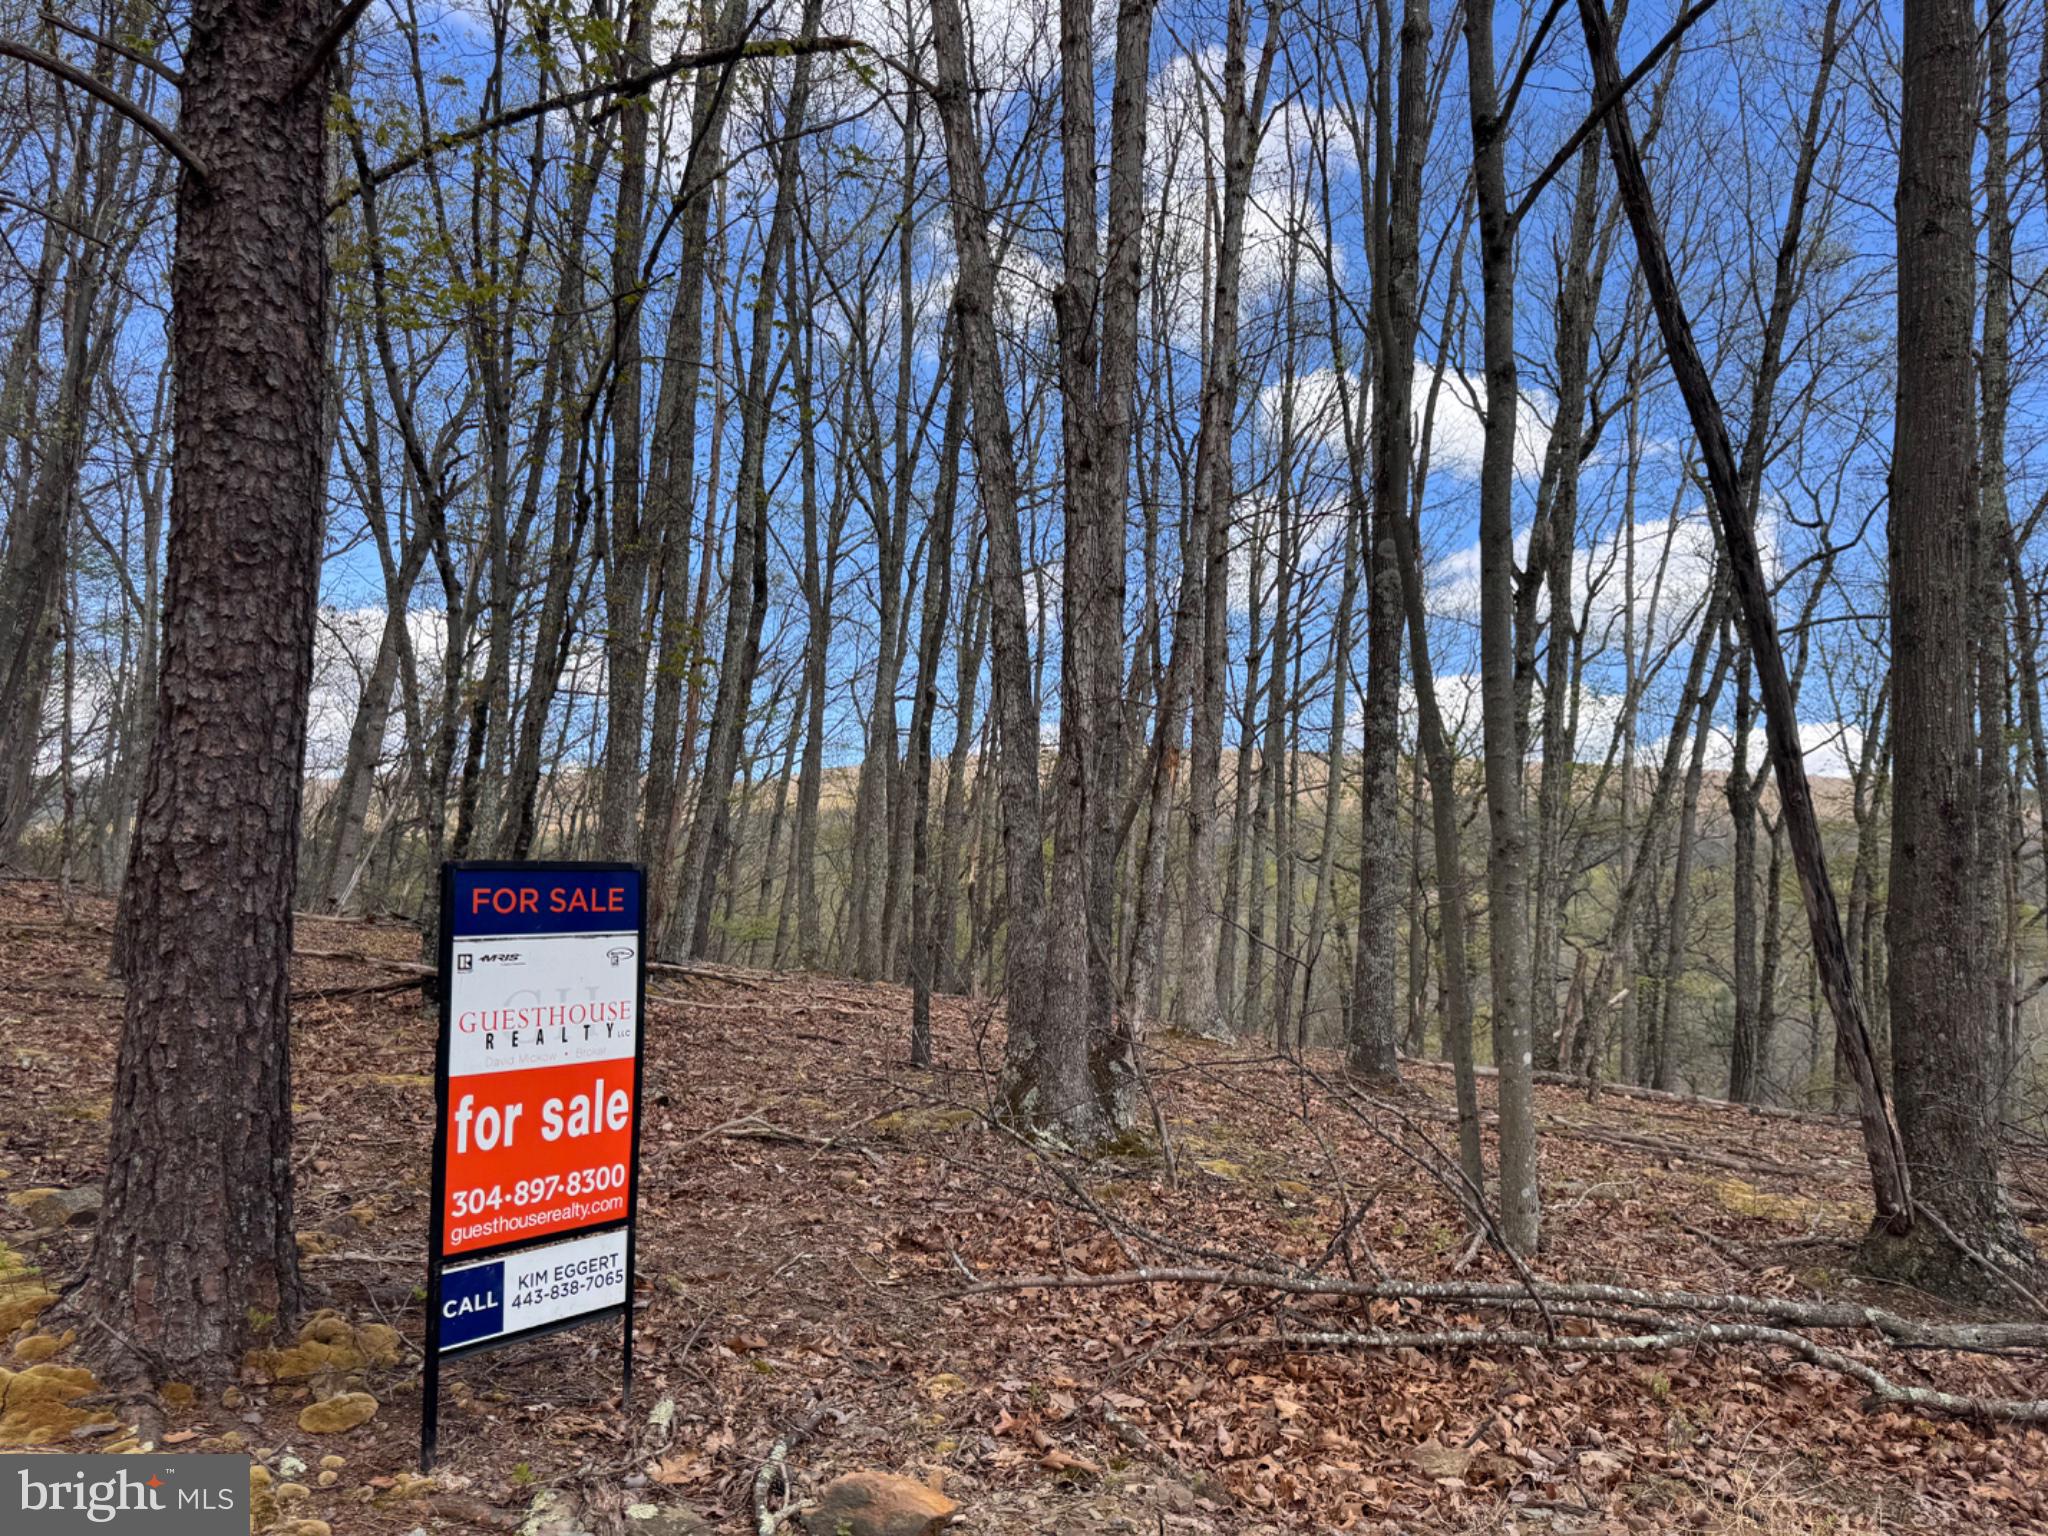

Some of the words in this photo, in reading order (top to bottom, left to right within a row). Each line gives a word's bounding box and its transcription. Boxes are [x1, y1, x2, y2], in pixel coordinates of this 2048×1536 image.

[472, 888, 539, 914] FOR
[550, 887, 625, 912] SALE
[458, 1000, 632, 1034] GUESTHOUSE
[486, 1023, 614, 1050] REALTY
[618, 1029, 631, 1039] LLC
[486, 1053, 514, 1067] David
[454, 1094, 523, 1153] for
[541, 1079, 629, 1142] sale
[451, 1196, 623, 1245] guesthouserealty.com
[518, 1268, 548, 1290] KIM
[555, 1253, 619, 1282] EGGERT
[442, 1291, 498, 1319] CALL
[511, 1269, 624, 1309] 443-838-7065
